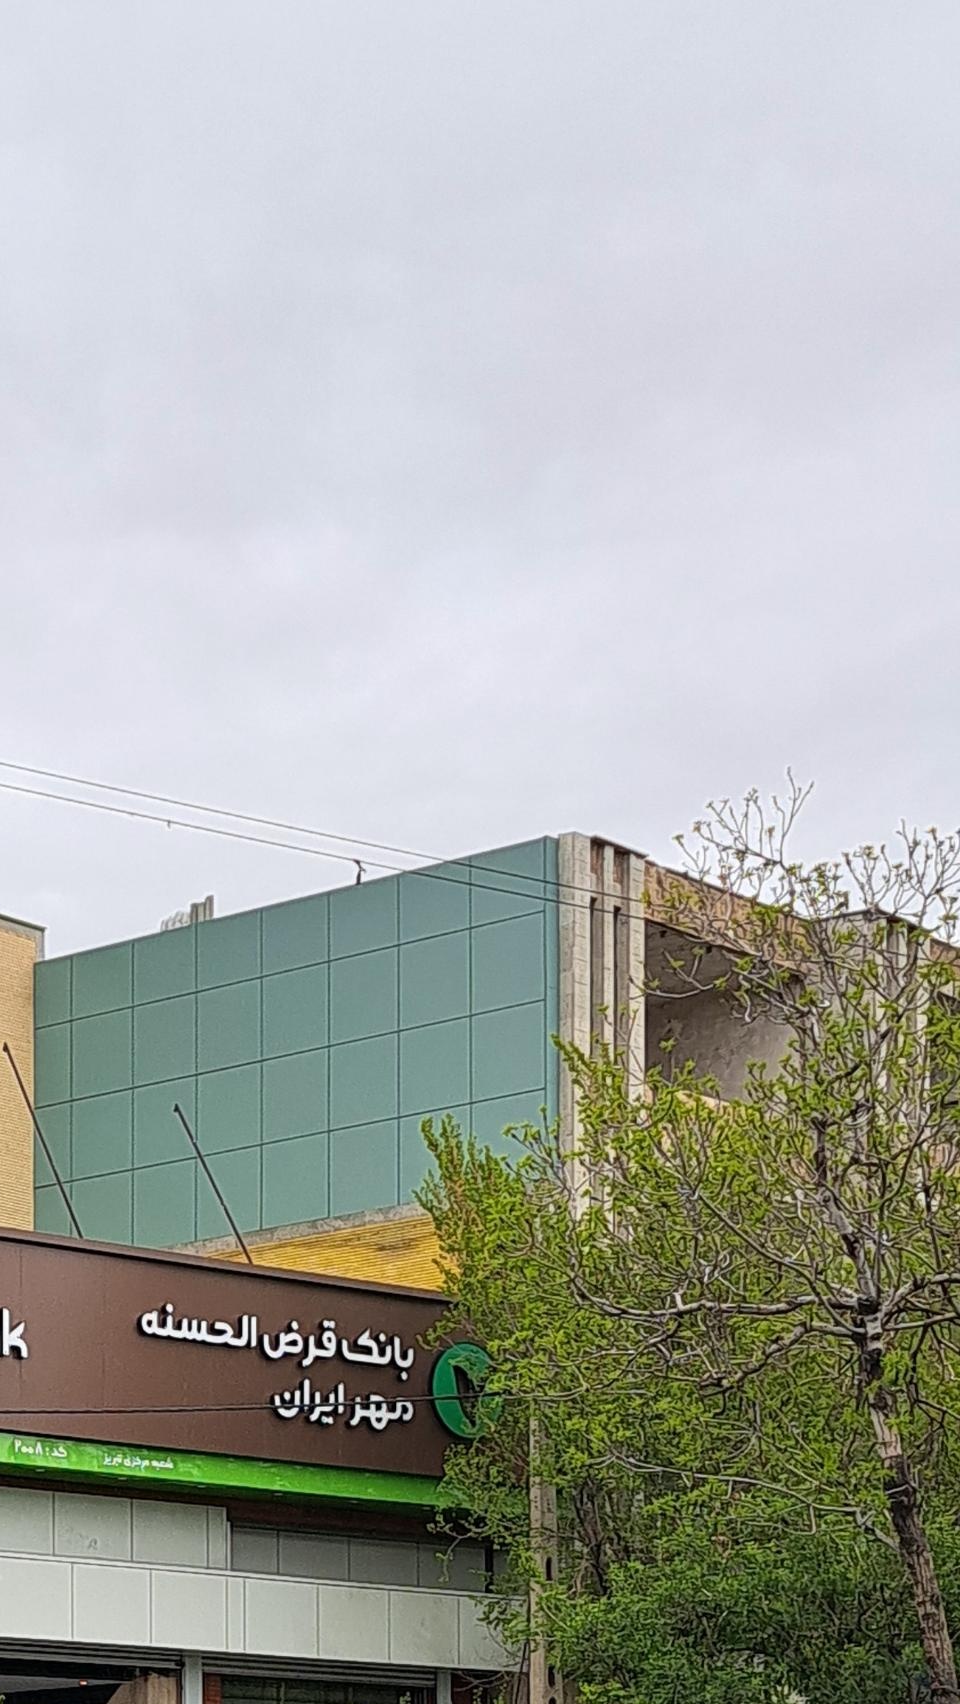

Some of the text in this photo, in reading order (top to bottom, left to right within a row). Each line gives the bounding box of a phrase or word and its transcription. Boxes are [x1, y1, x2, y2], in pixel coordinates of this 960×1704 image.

[139, 1302, 415, 1381] بانک قرض الحسنه
[272, 1377, 415, 1431] مهر ایران
